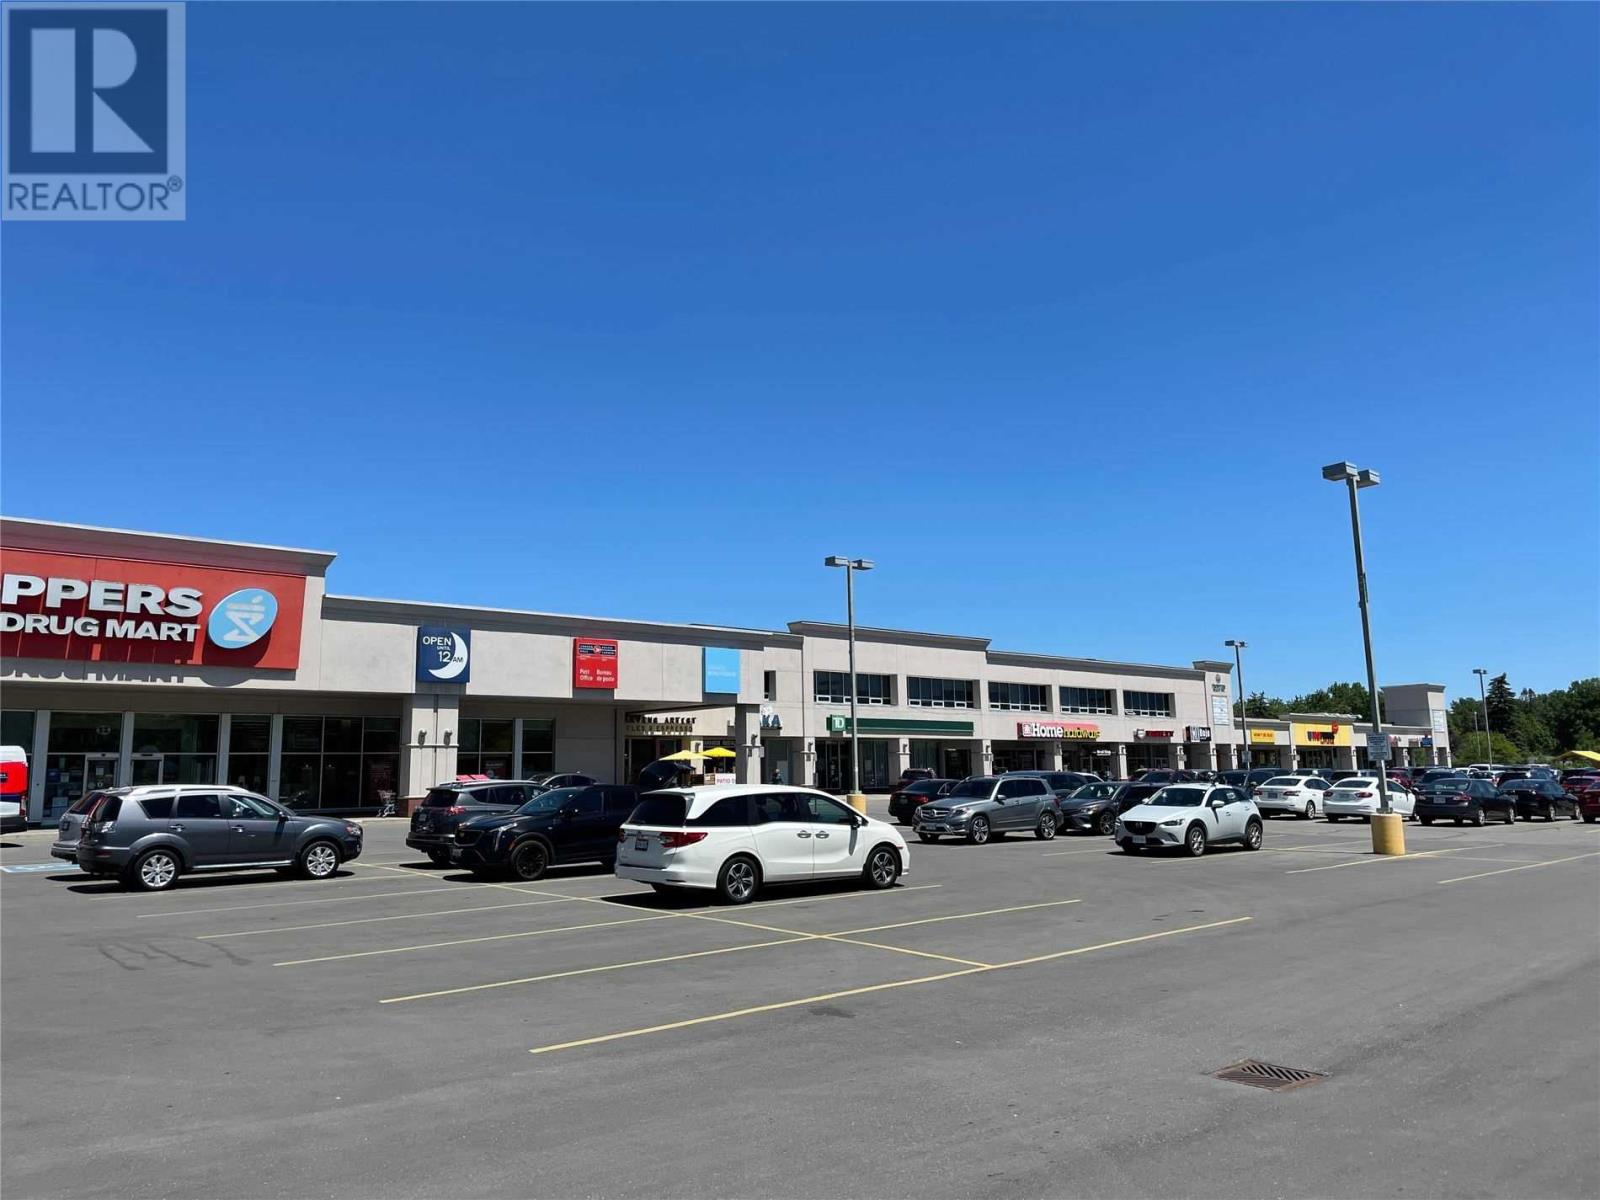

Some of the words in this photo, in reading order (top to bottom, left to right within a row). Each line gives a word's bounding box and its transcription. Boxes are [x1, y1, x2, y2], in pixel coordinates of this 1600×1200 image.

[0, 611, 100, 637] DRUG
[105, 618, 201, 643] MART
[422, 636, 452, 646] OPEN
[438, 651, 451, 663] 12
[760, 714, 781, 728] KA
[832, 717, 845, 729] TD
[1032, 723, 1064, 738] Home
